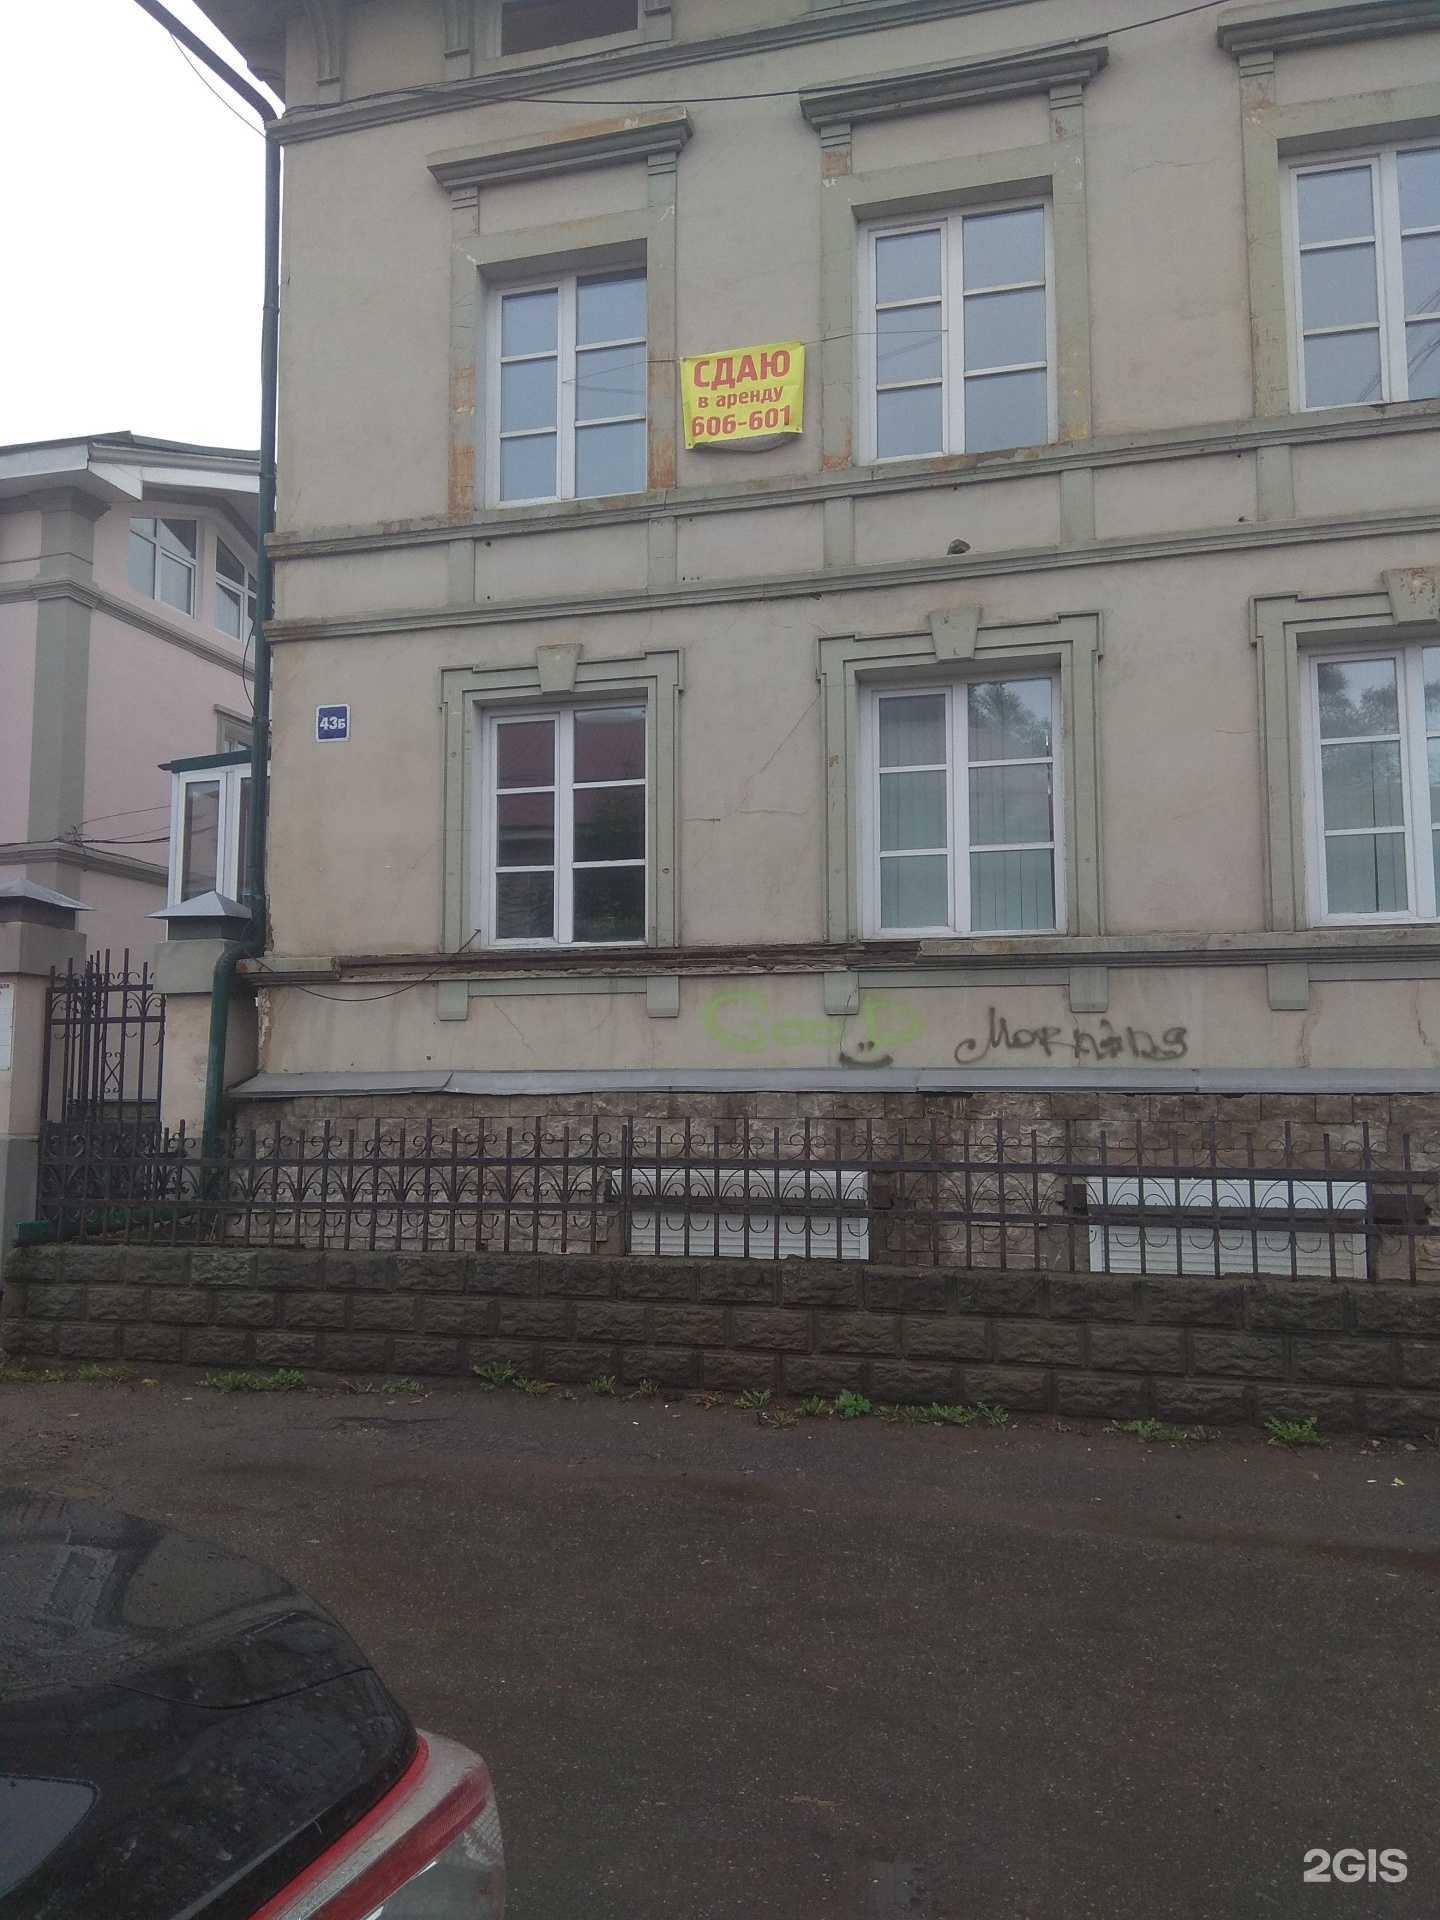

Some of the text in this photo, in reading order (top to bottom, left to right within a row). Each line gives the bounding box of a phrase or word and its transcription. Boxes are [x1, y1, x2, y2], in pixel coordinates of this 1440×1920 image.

[693, 350, 791, 391] СДАЮ
[697, 386, 784, 409] в аренду
[692, 405, 791, 437] 606-601
